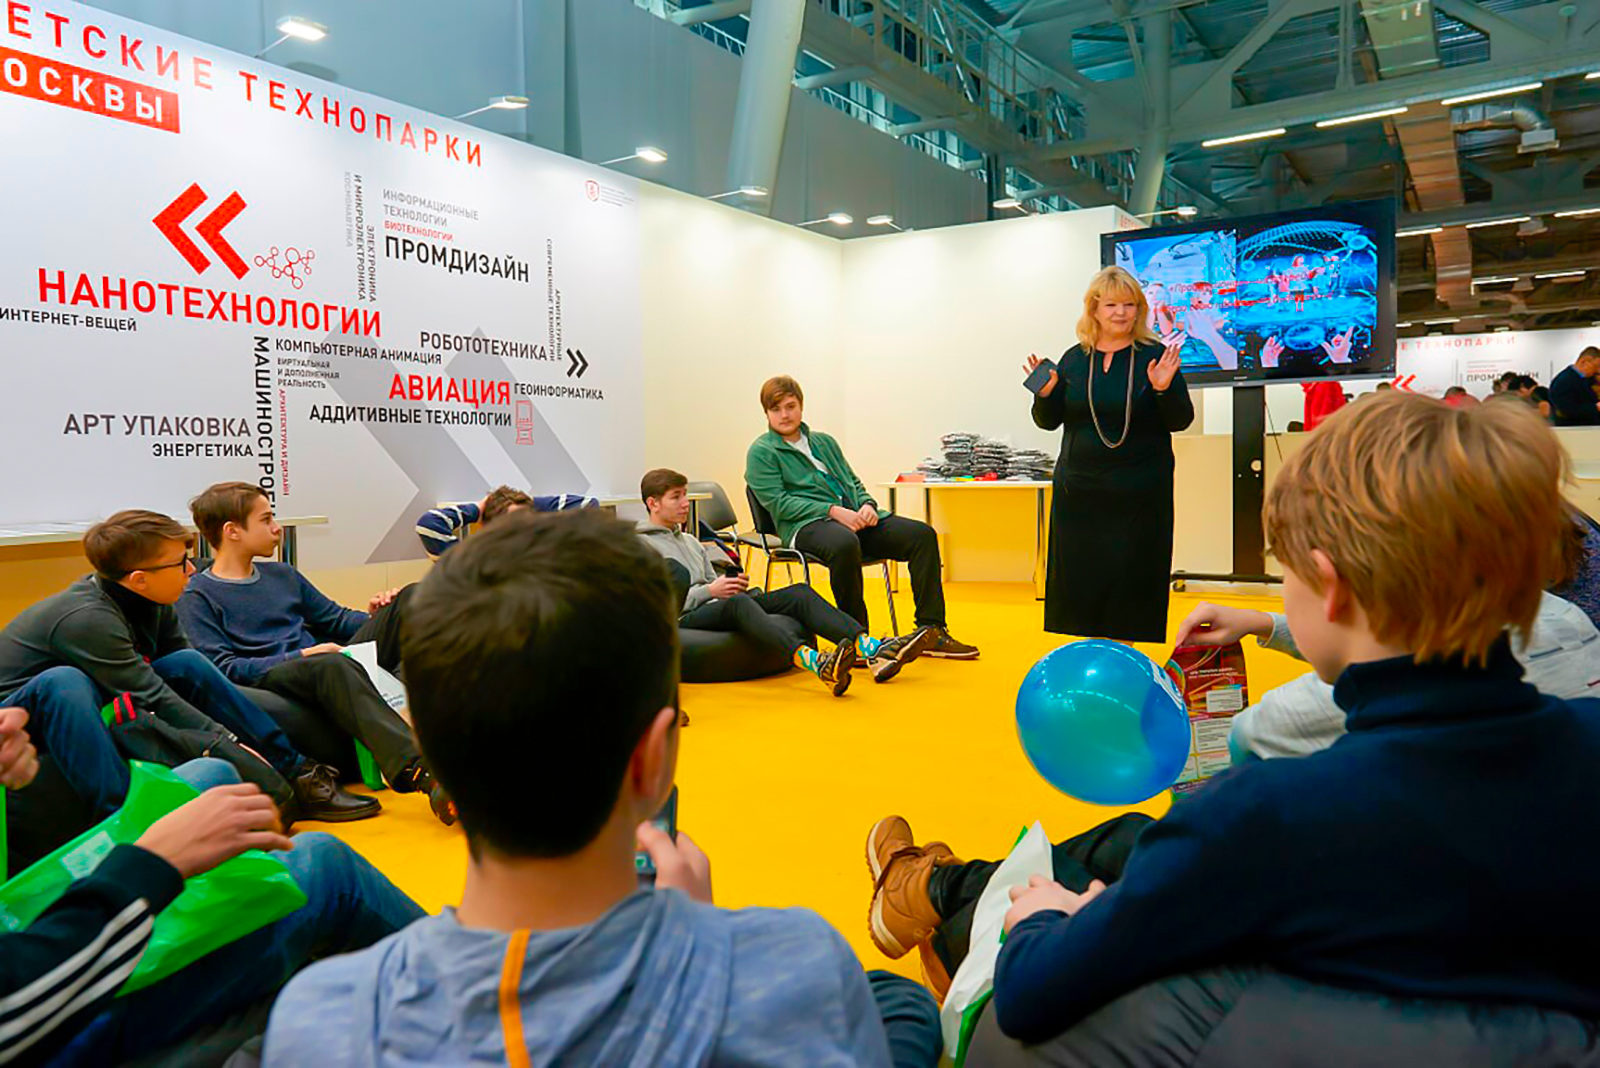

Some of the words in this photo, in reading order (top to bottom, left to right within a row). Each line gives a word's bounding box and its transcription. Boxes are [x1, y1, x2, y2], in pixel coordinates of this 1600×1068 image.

[4, 58, 162, 122] ОСКВЫ
[7, 0, 213, 90] ЕТСКИЕ
[239, 70, 481, 167] ТЕХНОПАРКИ
[383, 188, 480, 221] ИНФОРМАЦИОННЫЕ
[383, 203, 448, 227] ТЕХНОЛОГИИ
[354, 184, 366, 301] МИКРОЭЛЕКТРОНИКА
[384, 220, 454, 242] БИОТЕХНОЛОГИИ
[366, 225, 377, 302] ЭЛЕКТРОНИКА
[385, 235, 530, 283] ПРОМДИЗАЙН
[38, 267, 381, 337] НАНОТЕХНОЛОГИИ
[276, 338, 377, 359] КОМПЬЮТЕРНАЯ
[380, 349, 442, 365] АНИМАЦИЯ
[420, 331, 548, 361] РОБОТОТЕХНИКА
[389, 374, 511, 408] АВИАЦИЯ
[514, 384, 603, 400] ГЕОИНФОРМАТИКА
[64, 414, 115, 435] АРТ
[123, 415, 251, 437] УПАКОВКА
[254, 336, 275, 516] МАШИНОСТРО
[309, 404, 421, 423] АДДИТИВНЫЕ
[426, 409, 511, 426] ТЕХНОЛОГИИ
[153, 443, 253, 457] ЭНЕРГЕТИКА
